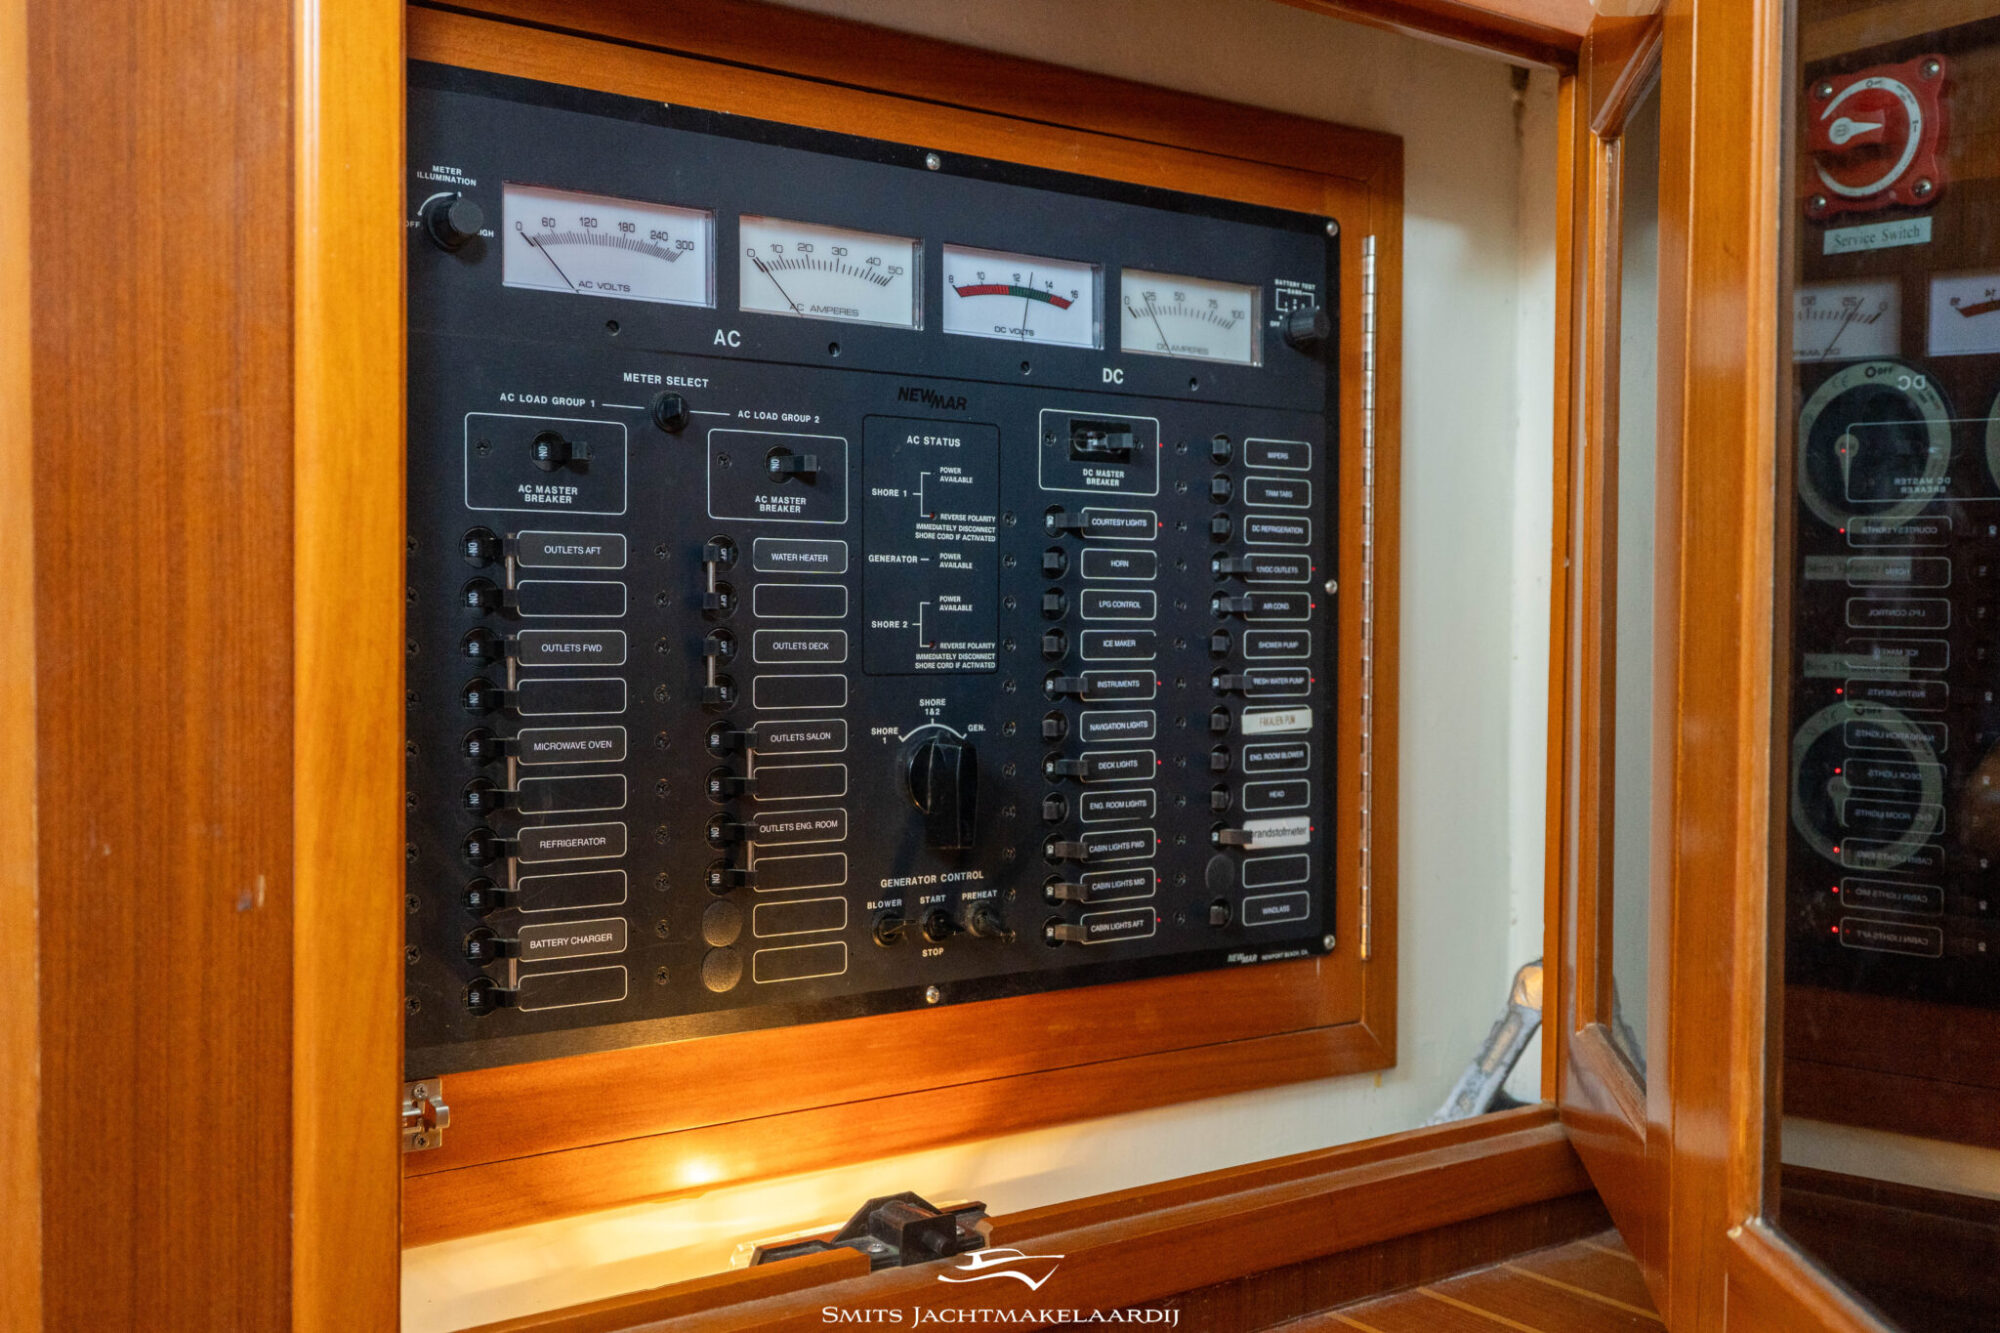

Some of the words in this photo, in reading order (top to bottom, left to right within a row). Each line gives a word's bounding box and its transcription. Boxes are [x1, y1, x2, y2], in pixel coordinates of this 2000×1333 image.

[432, 165, 462, 175] METER
[416, 171, 476, 186] ILLUMINATION
[516, 222, 522, 232] 0
[542, 217, 556, 228] 60
[579, 216, 598, 229] 120
[618, 221, 635, 234] 180
[650, 229, 668, 242] 240
[675, 240, 695, 252] 300
[1834, 232, 1876, 250] Service
[1882, 224, 1920, 242] Switch
[746, 248, 756, 258] 0
[770, 244, 784, 254] 10
[797, 242, 814, 254] 20
[831, 246, 848, 257] 30
[866, 256, 882, 266] 40
[888, 266, 904, 276] 50
[578, 280, 594, 290] AC
[597, 282, 631, 293] VOLTS
[976, 271, 986, 281] 10
[1012, 272, 1021, 283] 12
[1044, 280, 1054, 290] 14
[1070, 290, 1079, 300] 16
[810, 305, 860, 318] AMPERES
[994, 326, 1007, 334] DC
[1008, 327, 1034, 337] VOLTS
[714, 329, 741, 348] AC
[623, 372, 662, 386] METER
[665, 376, 709, 388] SELECT
[1102, 368, 1124, 385] DC
[500, 392, 515, 402] AC
[519, 394, 548, 404] LOAD
[552, 397, 586, 407] GROUP
[590, 400, 596, 408] 1
[898, 386, 968, 410] NEWMAR
[738, 410, 750, 419] AC
[754, 411, 778, 421] LOAD
[782, 413, 812, 423] GROUP
[814, 415, 820, 424] 2
[906, 434, 920, 445] AC
[923, 436, 961, 448] STATUS
[940, 466, 962, 474] POWER
[1082, 468, 1094, 476] DC
[1096, 470, 1124, 478] MASTER
[940, 476, 973, 484] AVAILABLE
[1086, 478, 1120, 487] BREAKER
[518, 484, 532, 494] AC
[535, 486, 578, 496] MASTER
[872, 488, 900, 496] SHORE
[524, 494, 572, 504] BREAKER
[754, 495, 768, 504] AC
[770, 496, 807, 506] MASTER
[759, 504, 801, 514] BREAKER
[940, 513, 966, 521] REVERSE
[968, 514, 996, 522] POLARITY
[1092, 518, 1124, 526] COURTESY
[1126, 519, 1148, 527] LIGHTS
[916, 523, 957, 532] IMMEDIATELY
[958, 525, 996, 534] DISCONNECT
[1262, 525, 1304, 534] REFRIGERATION
[962, 534, 996, 542] ACTIVATED
[544, 545, 582, 556] OUTLETS
[584, 546, 602, 556] AFT
[770, 552, 798, 562] WATER
[798, 553, 829, 564] HEATER
[868, 554, 918, 564] GENERATOR
[541, 642, 580, 653] OUTLETS
[582, 642, 602, 653] FWD
[772, 642, 806, 651] OUTLETS
[808, 642, 829, 651] DECK
[1097, 680, 1140, 688] INSTRUMENTS
[919, 698, 946, 706] SHORE
[924, 708, 940, 716] 1&2
[870, 726, 899, 735] SHORE
[968, 724, 986, 732] GEN.
[1090, 722, 1126, 732] NAVIGATION
[1126, 720, 1148, 730] LIGHTS
[770, 732, 804, 743] OUTLETS
[806, 732, 831, 741] SALON
[534, 740, 586, 751] MICROWAVE
[588, 740, 612, 750] OVEN
[1098, 762, 1116, 770] DECK
[1116, 760, 1138, 768] LIGHTS
[1106, 801, 1125, 810] ROOM
[1125, 800, 1148, 808] LIGHTS
[759, 822, 795, 834] OUTLETS
[796, 822, 813, 832] ENG.
[814, 820, 838, 830] ROOM
[1252, 826, 1307, 840] randstofmeter
[540, 836, 606, 849] REFRIGERATOR
[1088, 844, 1108, 853] CABIN
[1108, 842, 1130, 852] LIGHTS
[1130, 841, 1145, 850] FWD
[880, 874, 937, 888] GENERATOR
[940, 871, 984, 883] CONTROL
[1092, 882, 1112, 891] CABIN
[1112, 880, 1134, 890] LIGHTS
[1134, 878, 1146, 887] MID
[920, 894, 946, 904] START
[962, 890, 998, 900] PREHEAT
[866, 899, 902, 910] BLOWER
[1090, 924, 1110, 933] CABIN
[1110, 922, 1132, 932] LIGHTS
[1132, 920, 1144, 930] AFT
[530, 936, 568, 950] BATTERY
[570, 932, 613, 946] CHARGER
[922, 948, 944, 958] STOP
